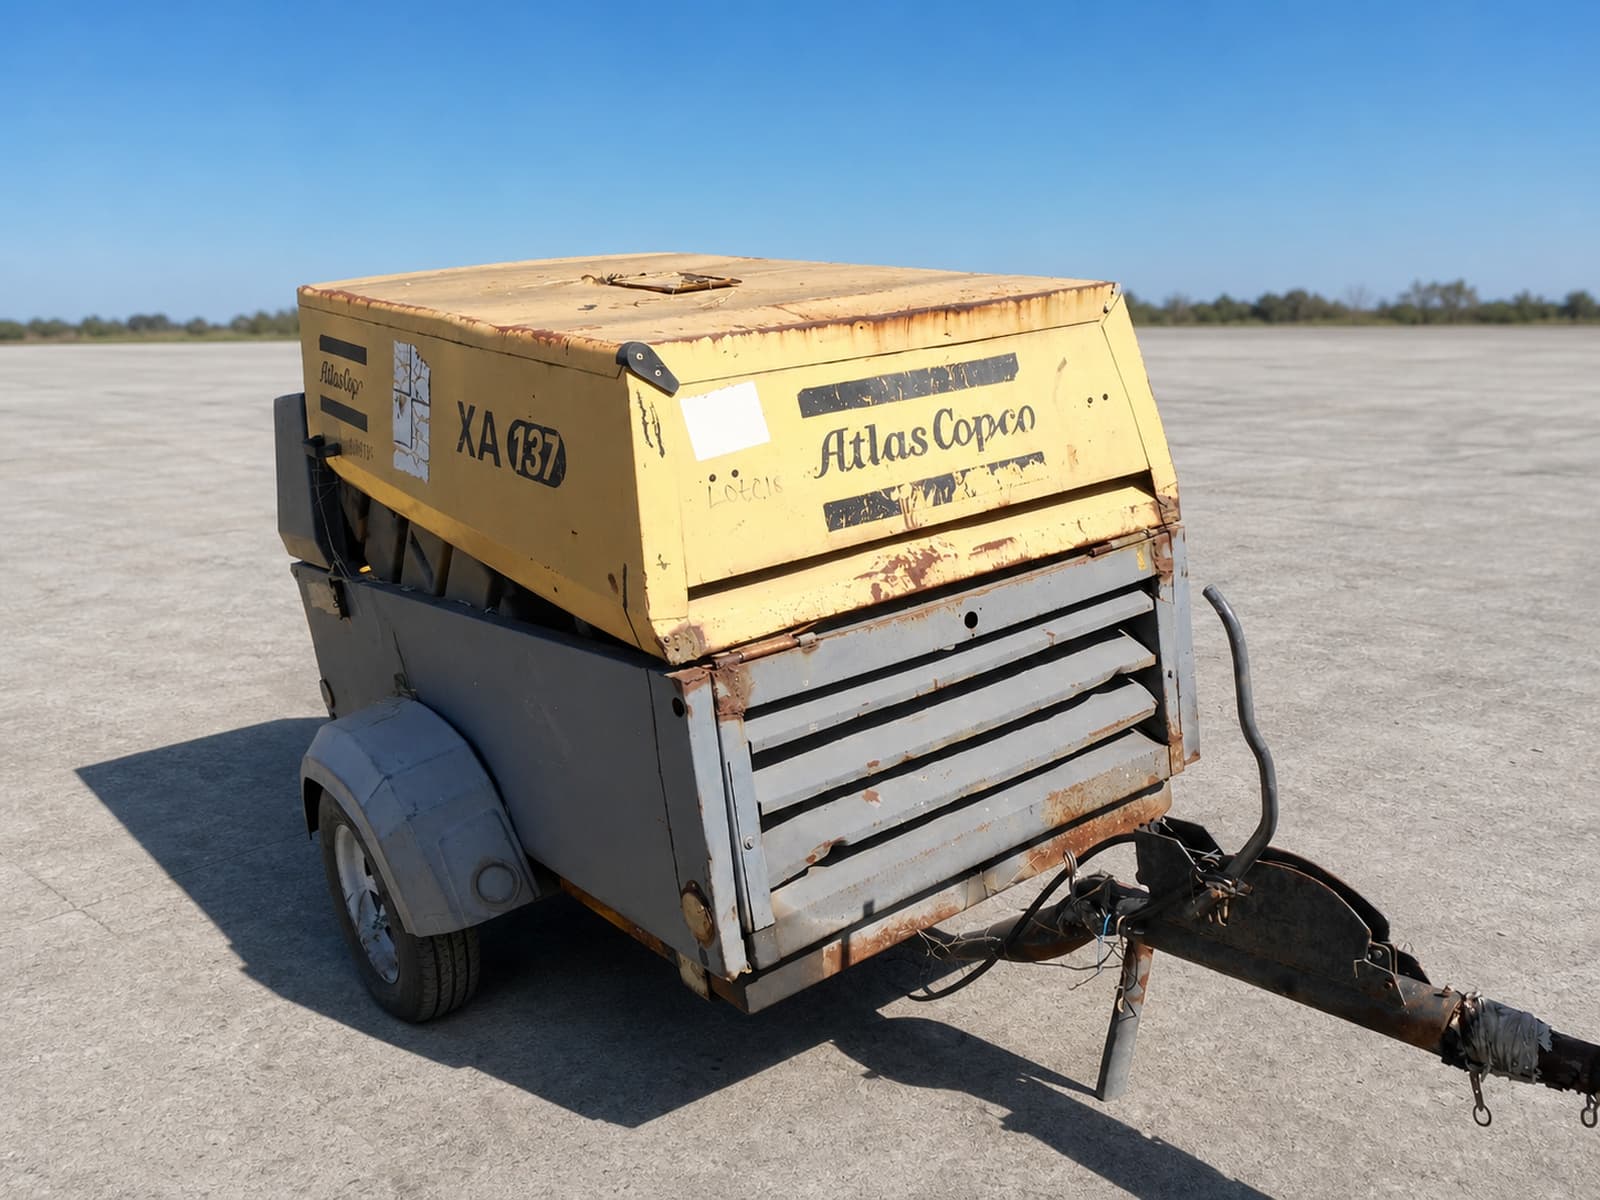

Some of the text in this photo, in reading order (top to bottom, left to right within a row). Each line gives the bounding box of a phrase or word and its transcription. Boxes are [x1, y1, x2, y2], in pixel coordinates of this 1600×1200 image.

[319, 360, 343, 390] Atlas
[456, 400, 561, 482] XA 137
[813, 405, 1036, 479] Atlas Copco
